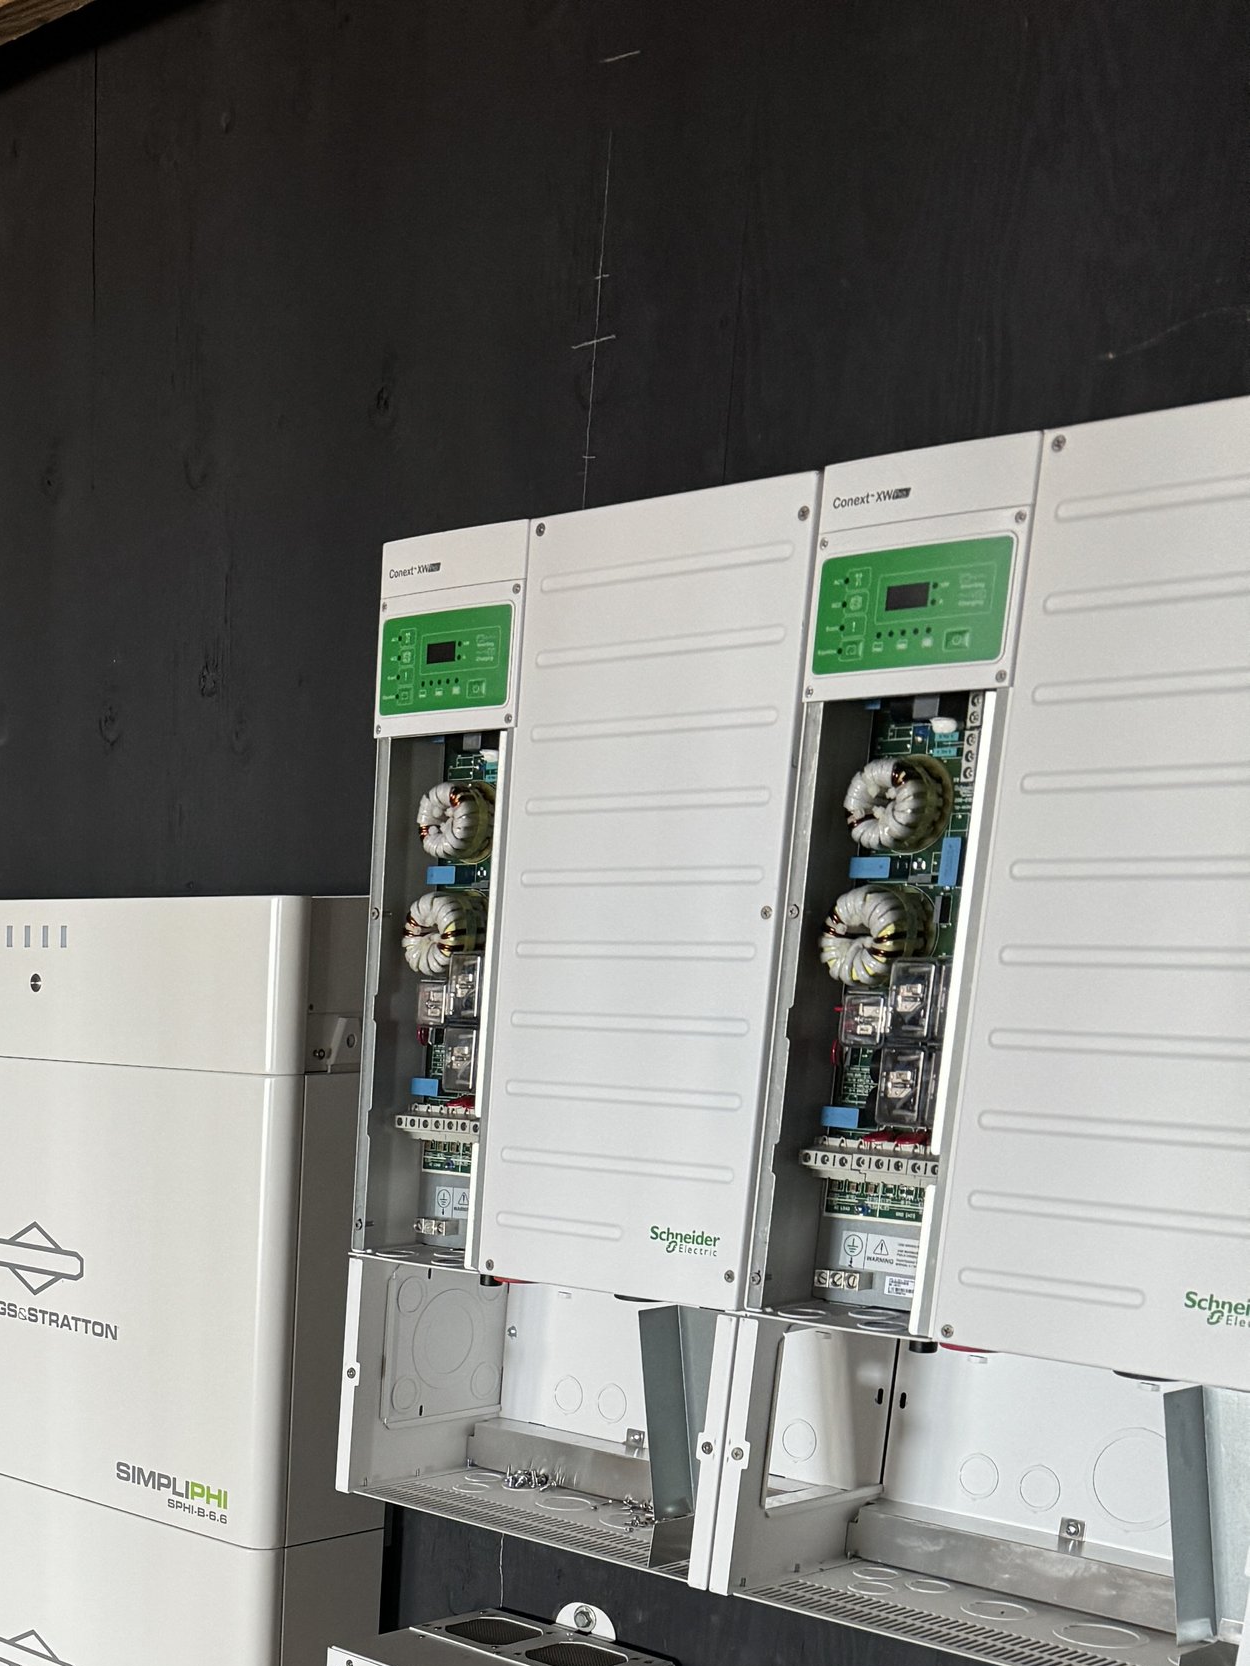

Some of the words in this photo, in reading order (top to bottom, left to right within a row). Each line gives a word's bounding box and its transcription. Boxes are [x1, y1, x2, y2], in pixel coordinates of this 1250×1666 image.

[649, 1225, 721, 1247] Schneider
[678, 1243, 718, 1257] Electric
[867, 1256, 894, 1265] WARNING
[115, 1461, 228, 1511] SIMPLIPHI
